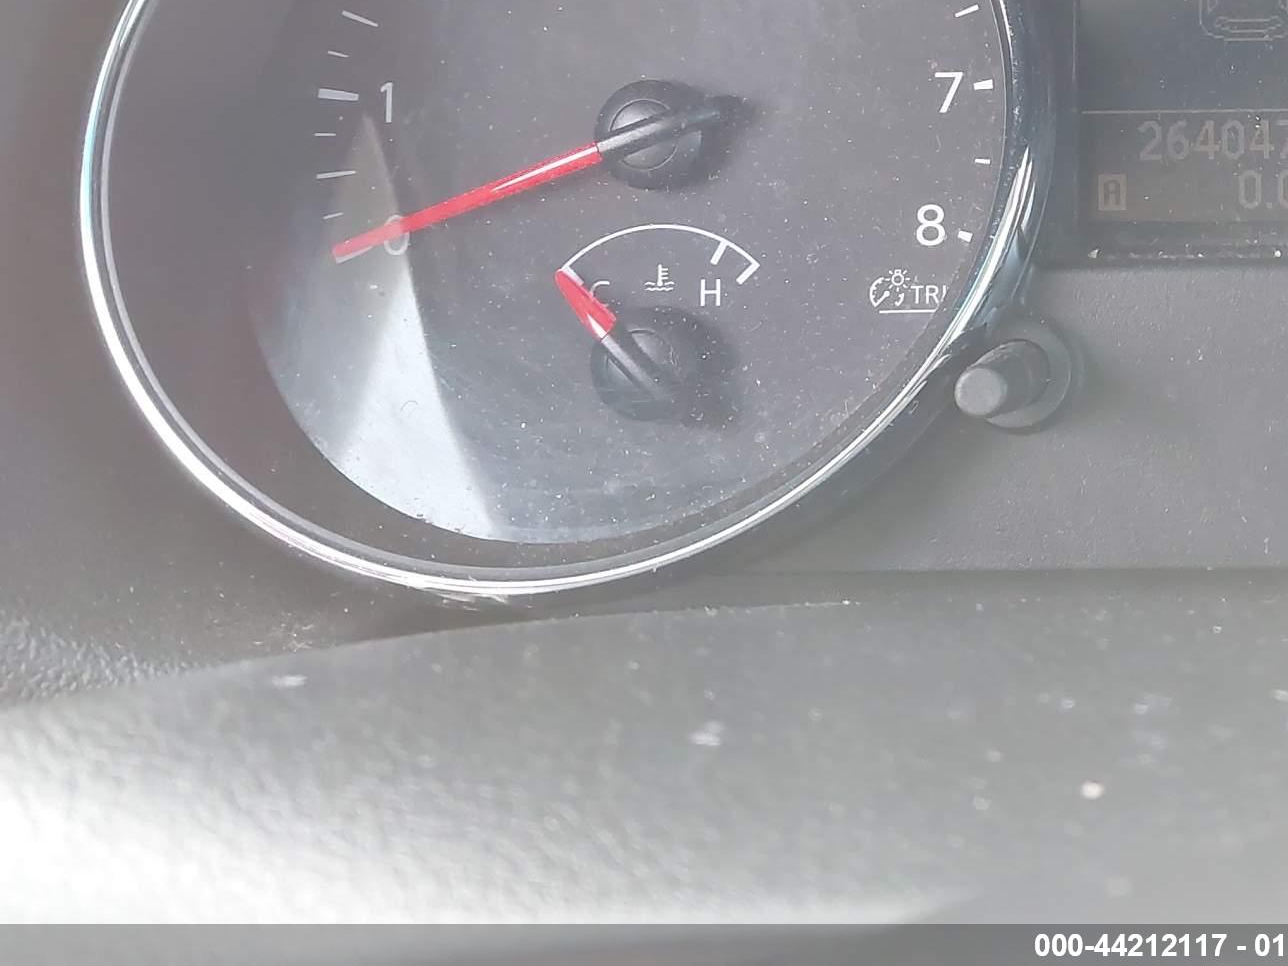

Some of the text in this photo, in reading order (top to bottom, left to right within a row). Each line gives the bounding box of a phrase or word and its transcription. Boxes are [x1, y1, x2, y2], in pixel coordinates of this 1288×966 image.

[380, 82, 394, 123] 1
[934, 71, 964, 114] 7
[916, 204, 948, 247] 8
[700, 278, 721, 307] H
